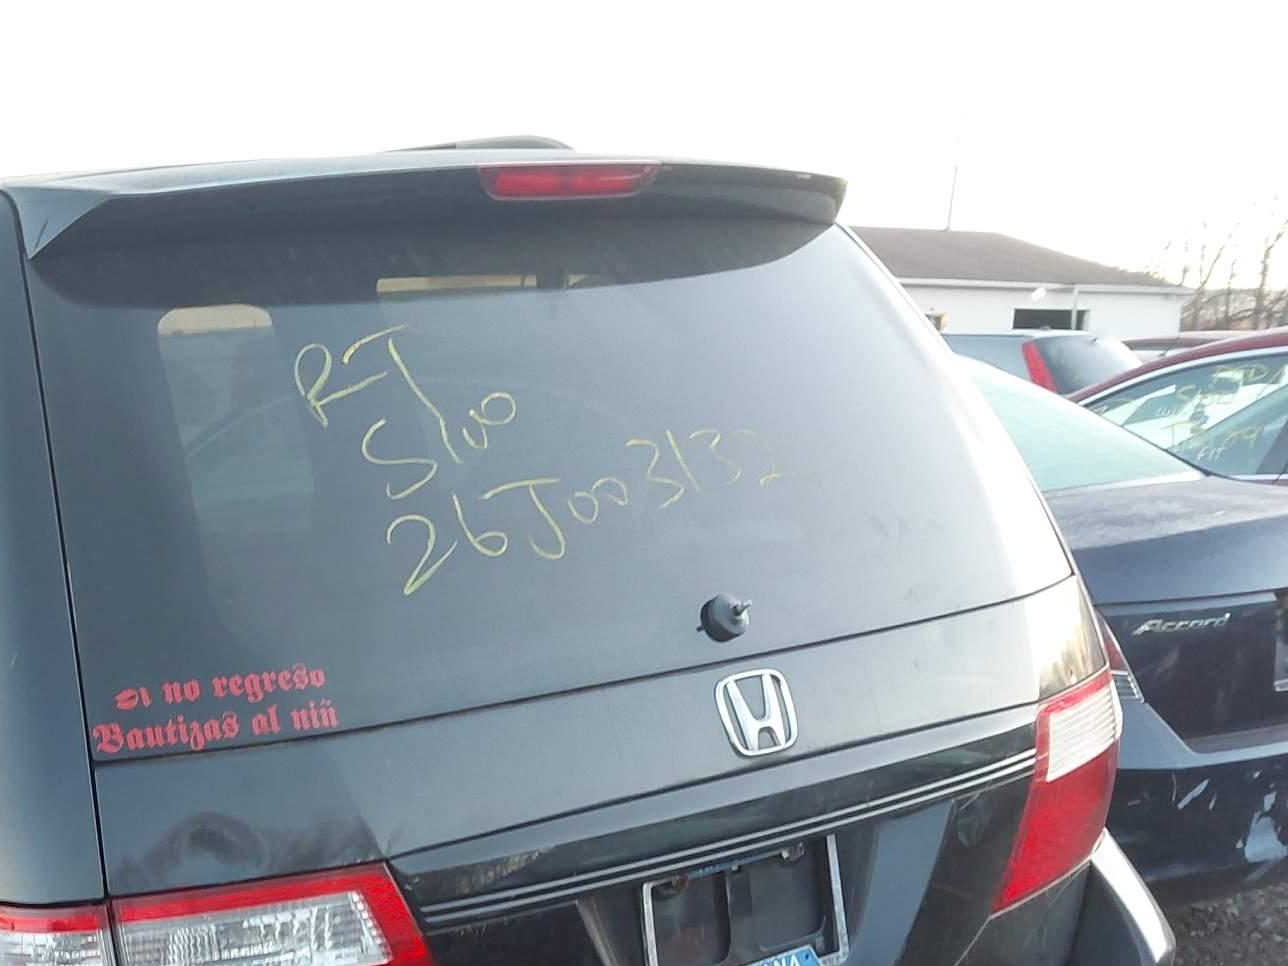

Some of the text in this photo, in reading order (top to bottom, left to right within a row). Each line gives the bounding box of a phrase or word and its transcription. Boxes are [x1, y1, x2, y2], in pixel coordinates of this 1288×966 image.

[1131, 612, 1232, 636] Accord
[163, 678, 201, 705] no
[211, 663, 326, 704] regreso
[92, 711, 240, 753] Bautizas
[251, 704, 282, 736] al
